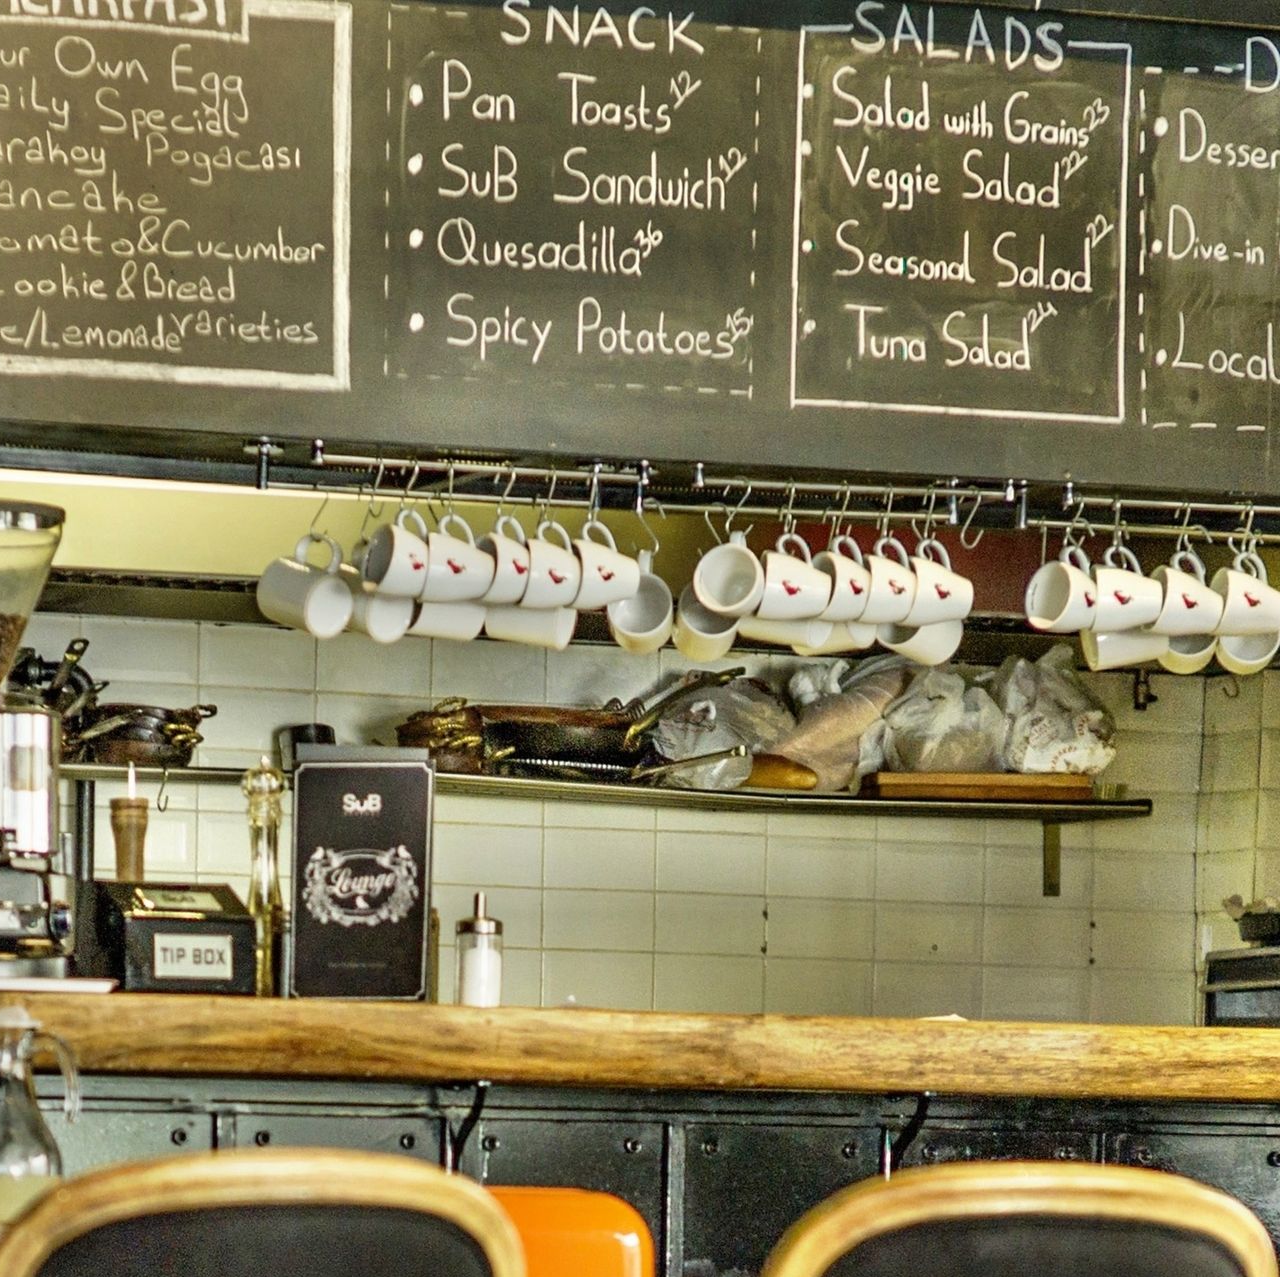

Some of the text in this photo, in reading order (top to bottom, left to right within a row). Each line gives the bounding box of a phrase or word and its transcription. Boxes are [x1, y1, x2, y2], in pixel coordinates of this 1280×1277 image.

[501, 0, 704, 54] SNACK
[851, 1, 1064, 72] SALADS
[54, 35, 149, 84] Own
[171, 43, 248, 124] Egg
[443, 59, 516, 122] Pan
[557, 71, 672, 134] Toasts
[832, 66, 930, 131] Salad
[943, 100, 994, 139] with
[1004, 91, 1090, 149] Grains
[95, 86, 240, 141] Special
[553, 147, 726, 211] Sandwich
[836, 145, 941, 211] Veggie
[962, 148, 1061, 209] Salad
[437, 217, 642, 277] Quesadilla
[833, 218, 976, 285] Seasonal
[992, 231, 1093, 294] Salad
[1167, 204, 1265, 266] Dive-in
[143, 262, 235, 301] Bread
[446, 293, 552, 364] Spicy
[577, 297, 734, 359] Potatoes
[844, 303, 927, 362] Tuna
[943, 311, 1031, 371] Salad
[160, 947, 226, 965] TIP BOX
